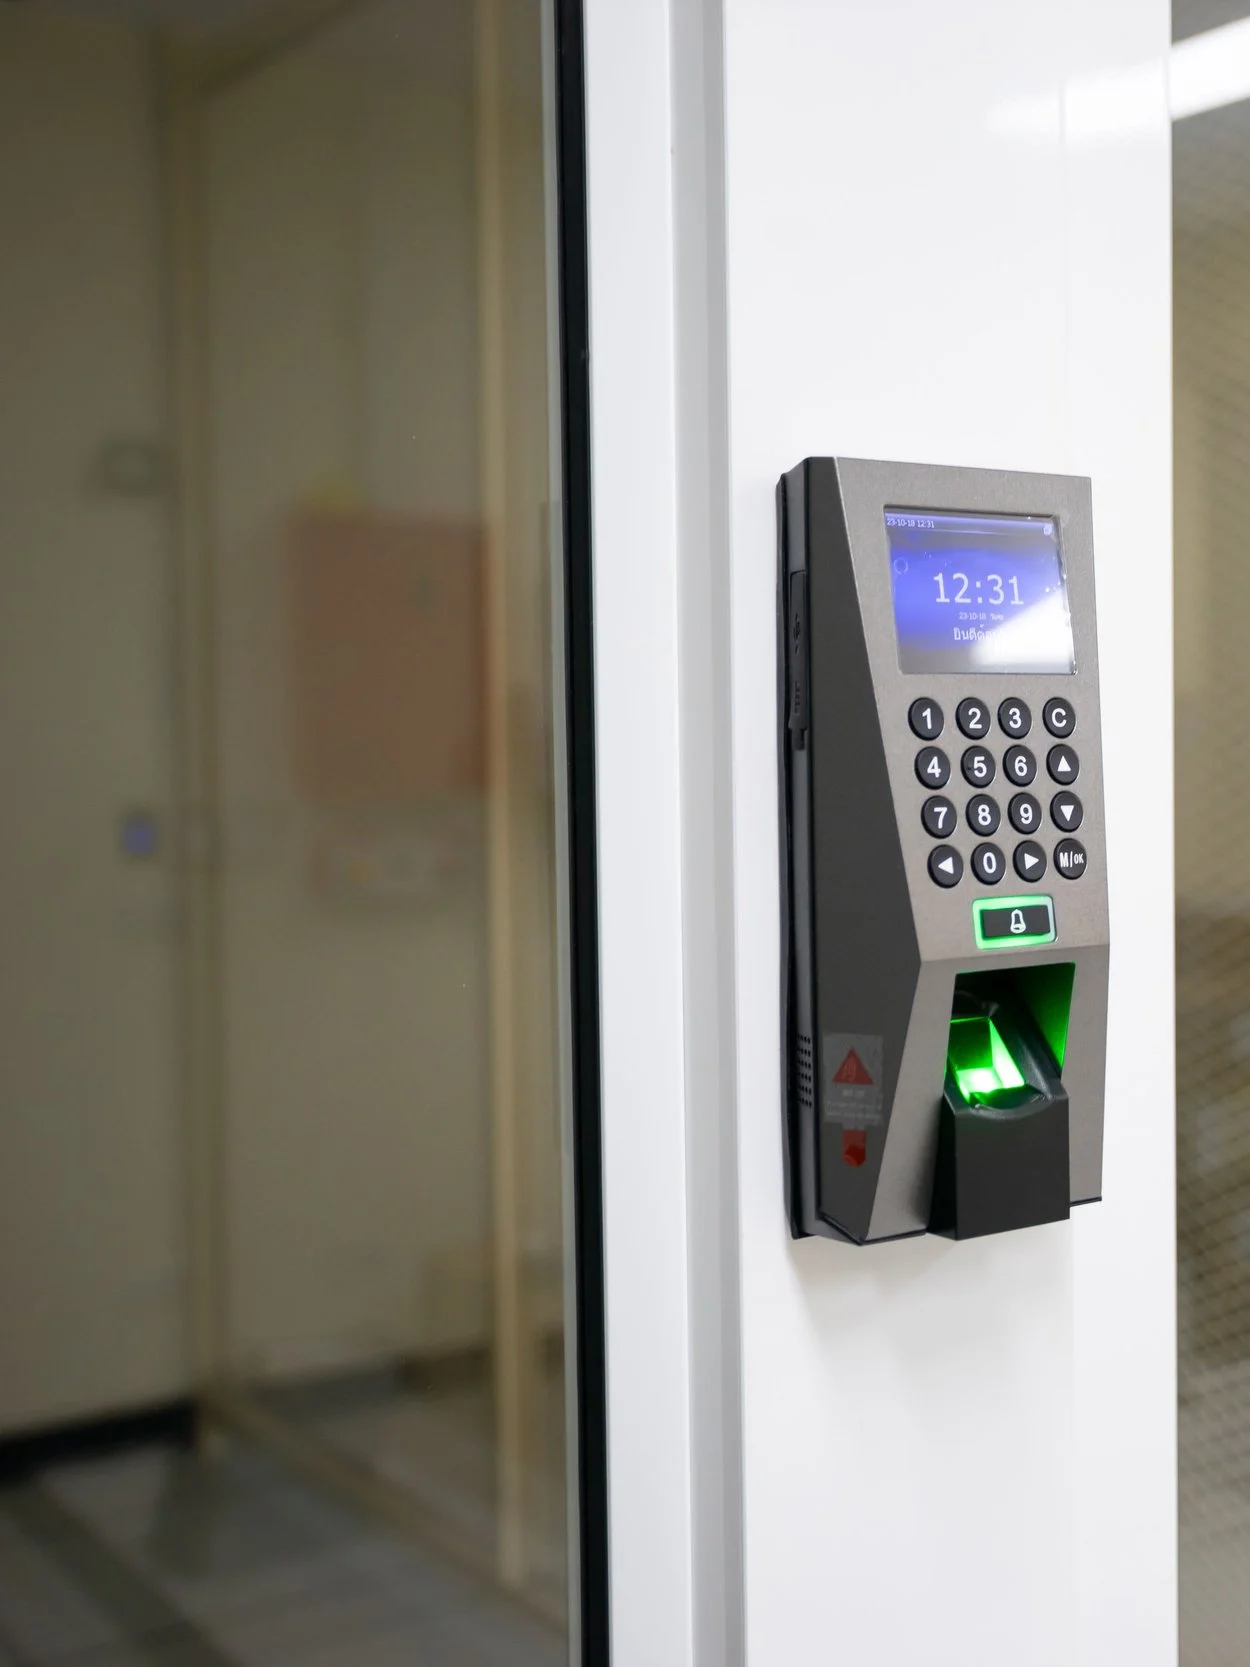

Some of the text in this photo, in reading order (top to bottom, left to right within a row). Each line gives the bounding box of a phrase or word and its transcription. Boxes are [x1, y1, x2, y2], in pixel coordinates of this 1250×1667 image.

[917, 519, 935, 529] 12:31
[933, 572, 1025, 605] 12:31
[922, 707, 1067, 729] 1 2 3 C
[927, 755, 1028, 778] 4 5 6
[933, 803, 1033, 829] 7 8 9
[982, 852, 997, 874] 0
